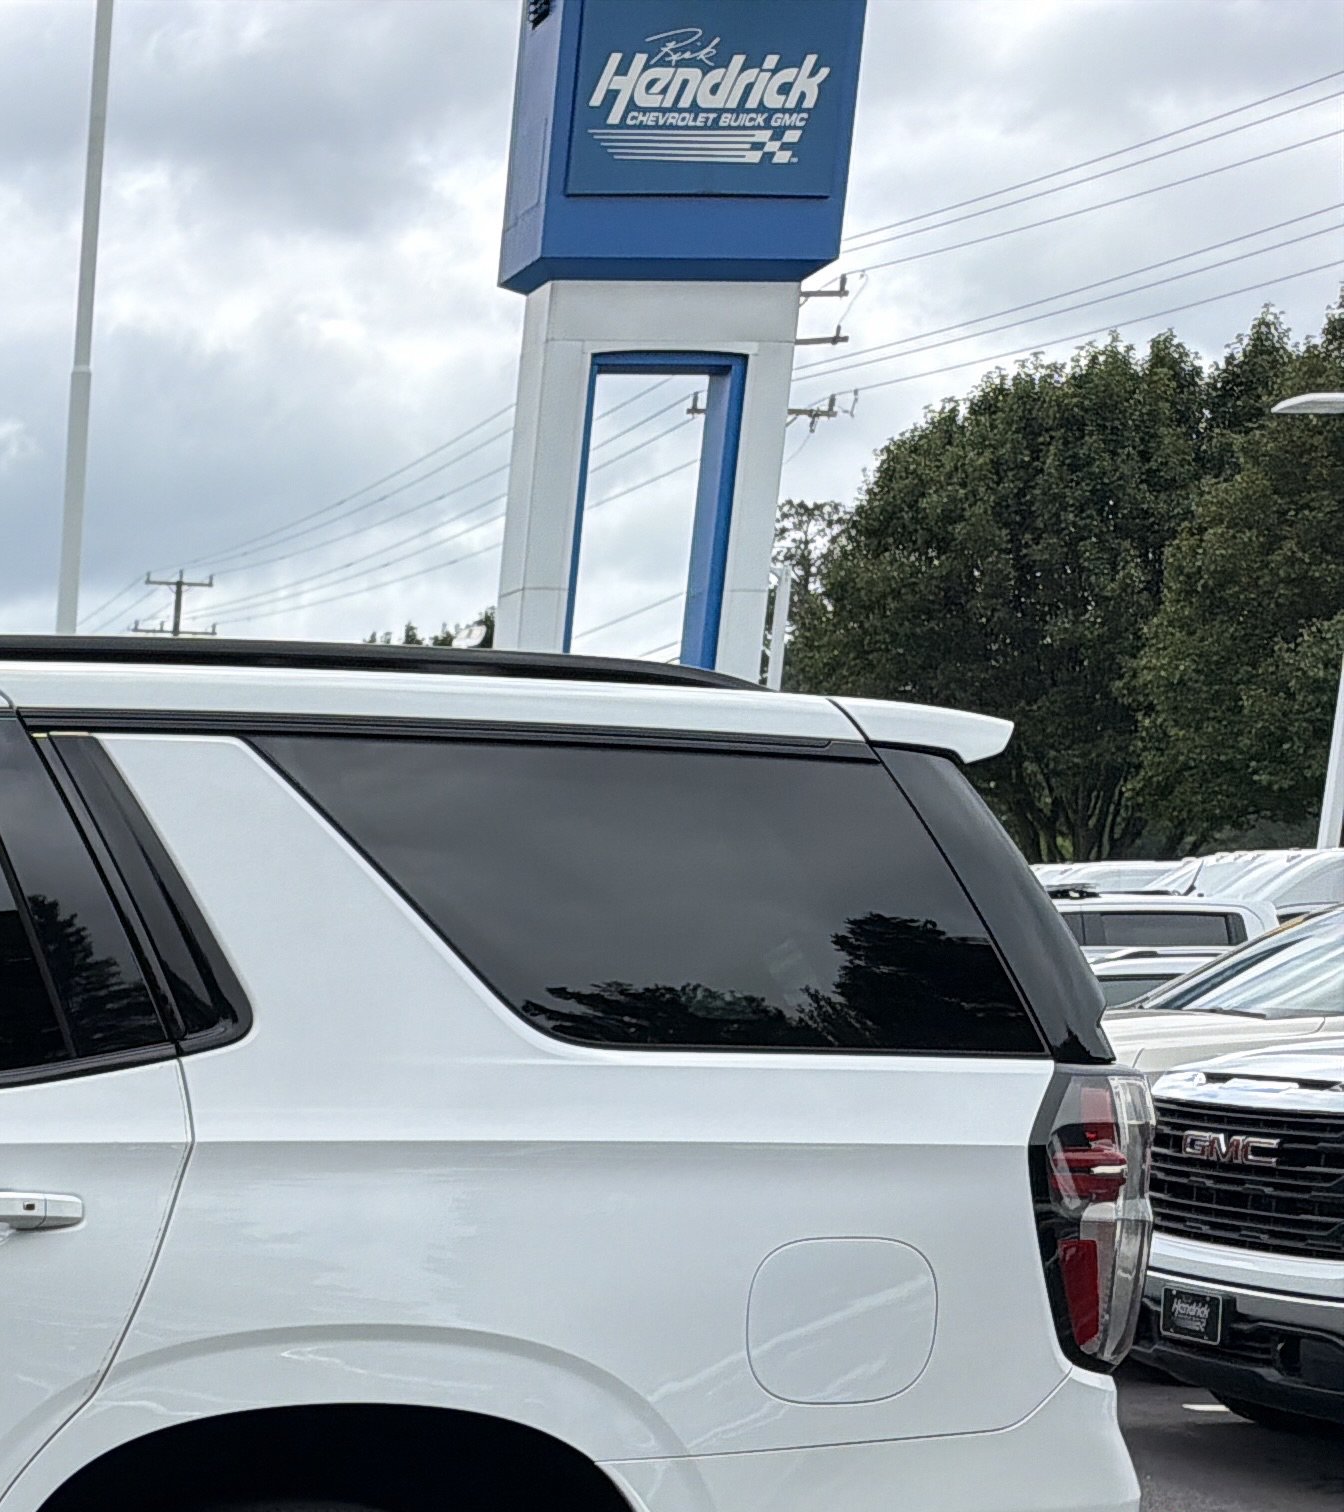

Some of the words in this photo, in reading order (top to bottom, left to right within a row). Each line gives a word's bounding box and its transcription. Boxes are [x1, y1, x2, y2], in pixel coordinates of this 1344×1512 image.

[645, 27, 720, 66] Rick
[588, 52, 831, 125] Hendrick
[625, 111, 718, 127] CHEVROLET
[718, 112, 769, 127] BUICK
[770, 112, 809, 127] GMC
[1181, 1130, 1280, 1169] GMC
[1171, 1298, 1211, 1319] Hendrick
